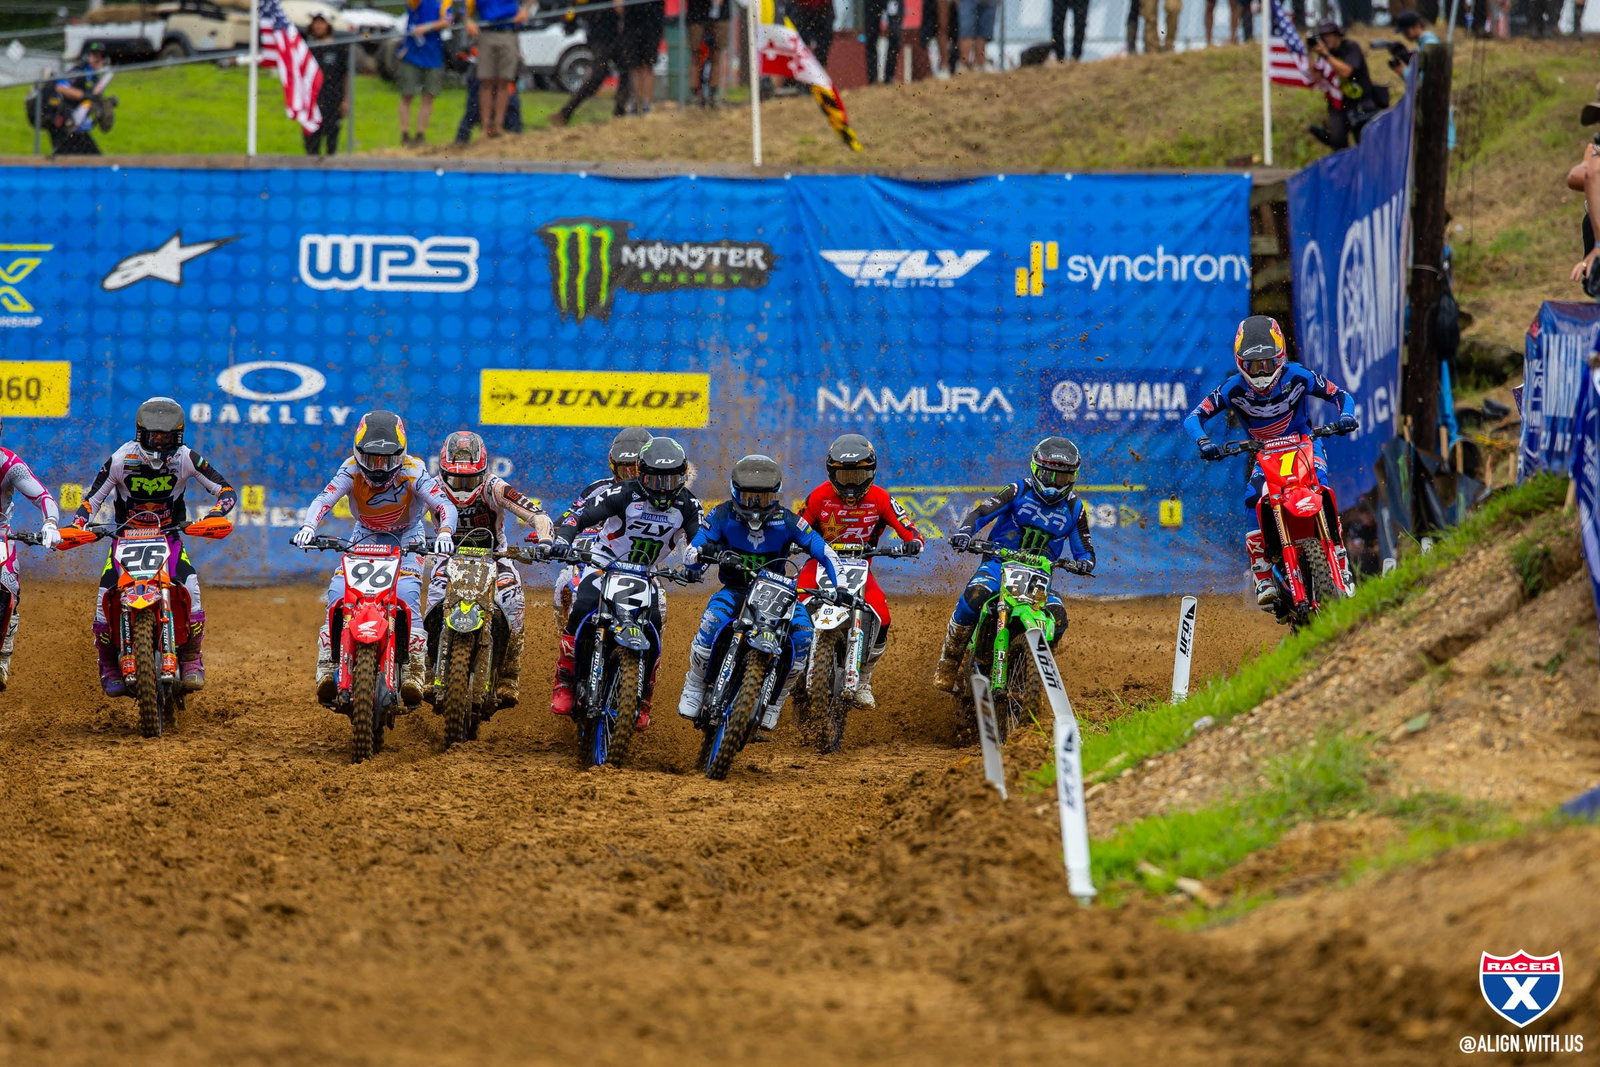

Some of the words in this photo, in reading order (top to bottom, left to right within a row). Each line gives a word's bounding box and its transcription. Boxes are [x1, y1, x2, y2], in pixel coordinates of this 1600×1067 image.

[300, 235, 479, 292] WPS
[621, 243, 768, 269] MONSTER
[820, 249, 990, 280] FLY
[0, 377, 41, 401] 60
[527, 388, 700, 410] DUNLOP
[817, 380, 1012, 413] NAMURA
[1083, 382, 1188, 411] YAMAHA
[190, 404, 351, 425] OAKLEY
[1279, 450, 1298, 477] 1
[130, 476, 173, 494] FOX
[627, 520, 674, 537] FLY
[645, 513, 668, 523] YAMAHA
[120, 544, 167, 572] 26
[351, 562, 393, 588] 96
[612, 577, 647, 607] 2
[1180, 619, 1190, 655] UFO
[591, 652, 601, 691] DUNLOP
[717, 653, 732, 691] DUNLOP
[1036, 654, 1057, 689] UFO
